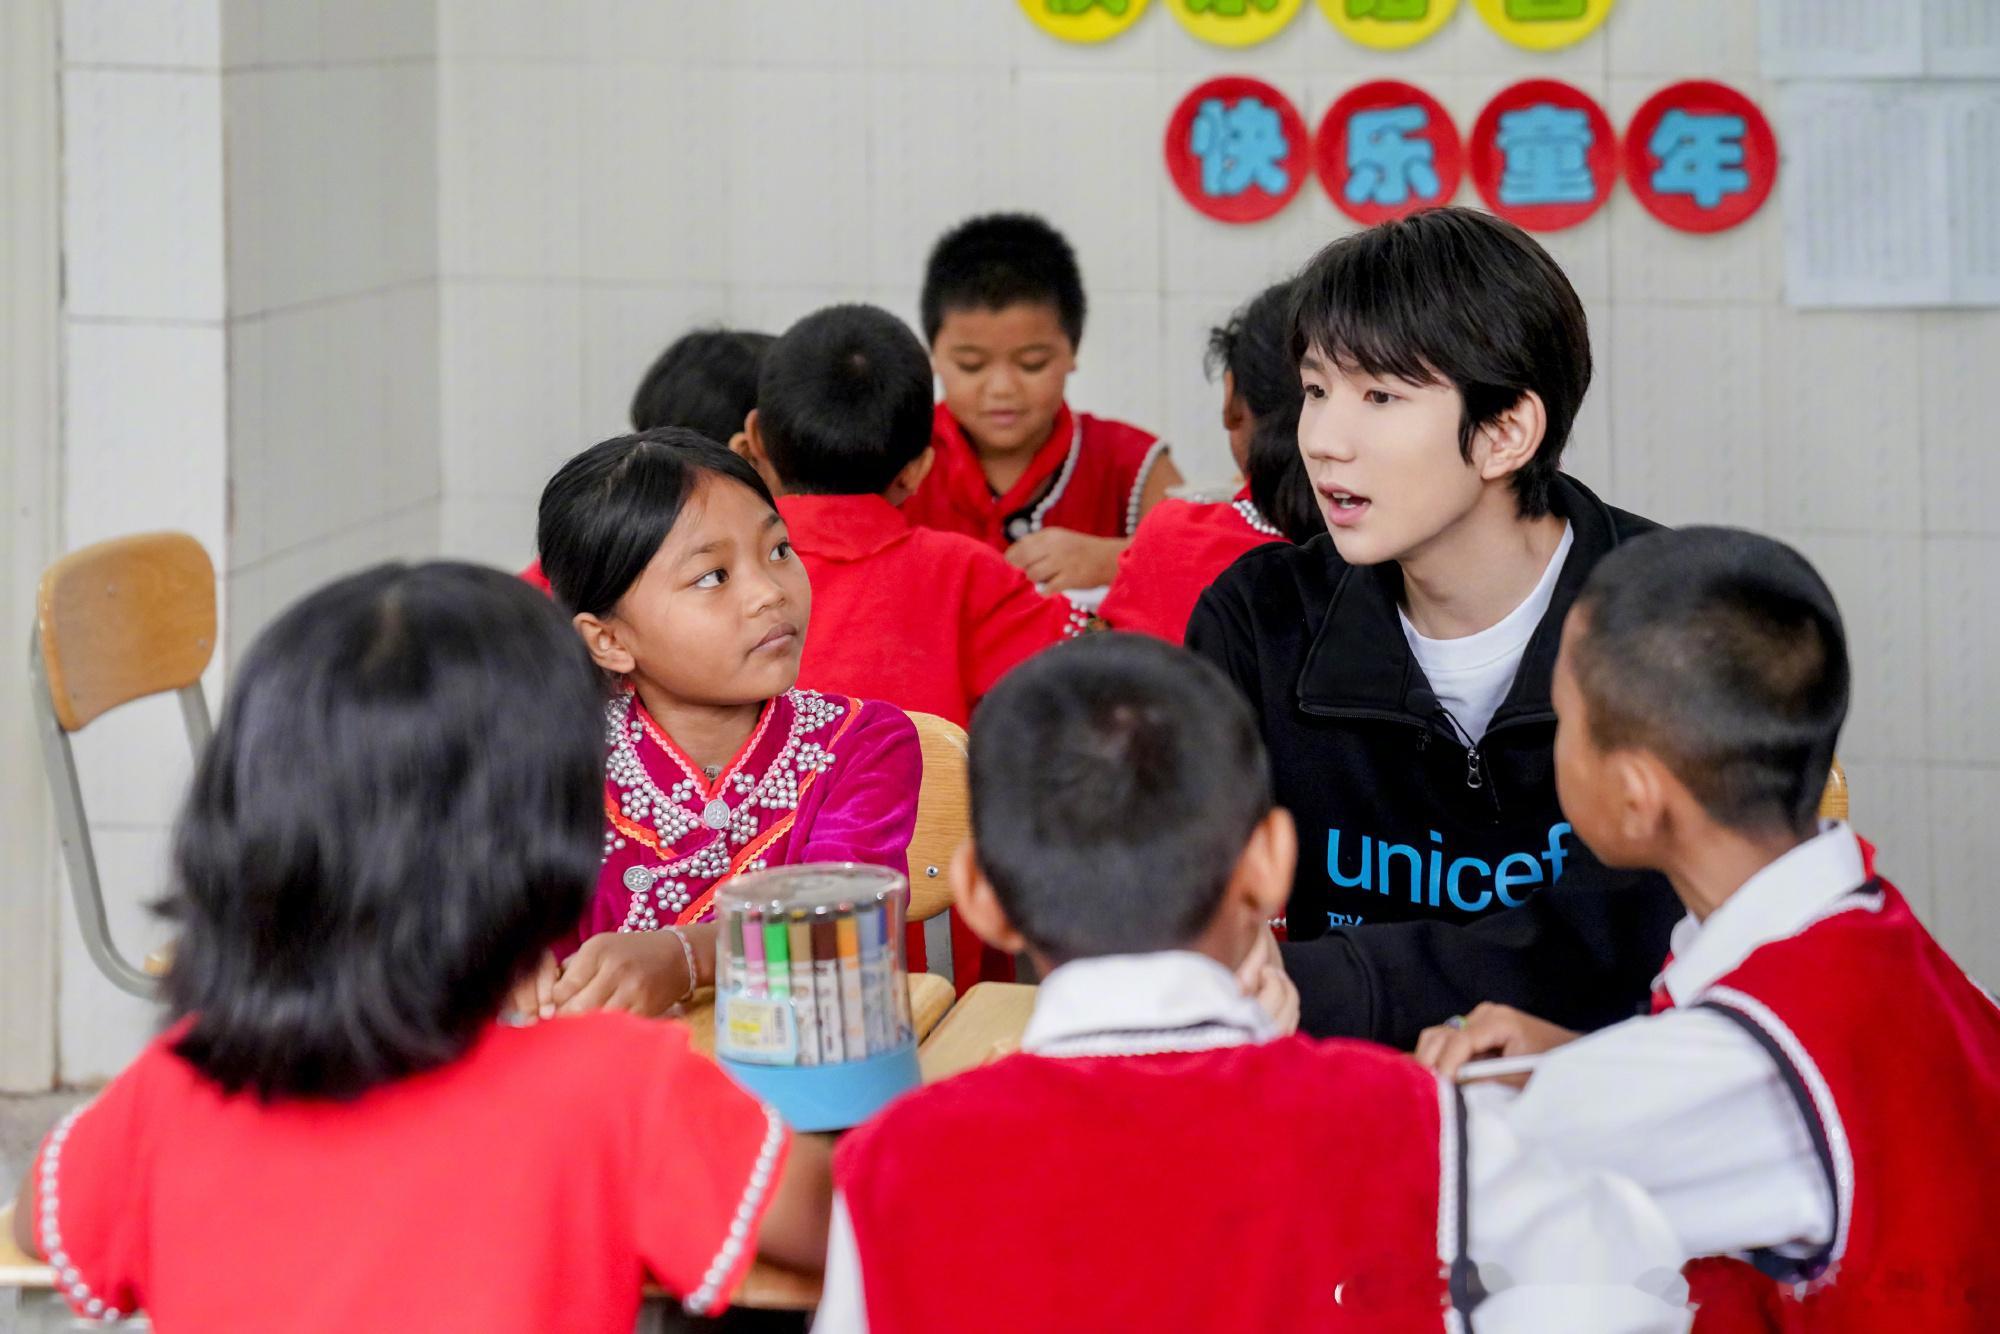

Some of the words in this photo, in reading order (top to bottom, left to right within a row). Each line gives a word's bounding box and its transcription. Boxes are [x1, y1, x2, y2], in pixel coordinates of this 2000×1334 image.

[1190, 96, 1749, 208] 快乐童年
[1327, 822, 1572, 912] unicef
